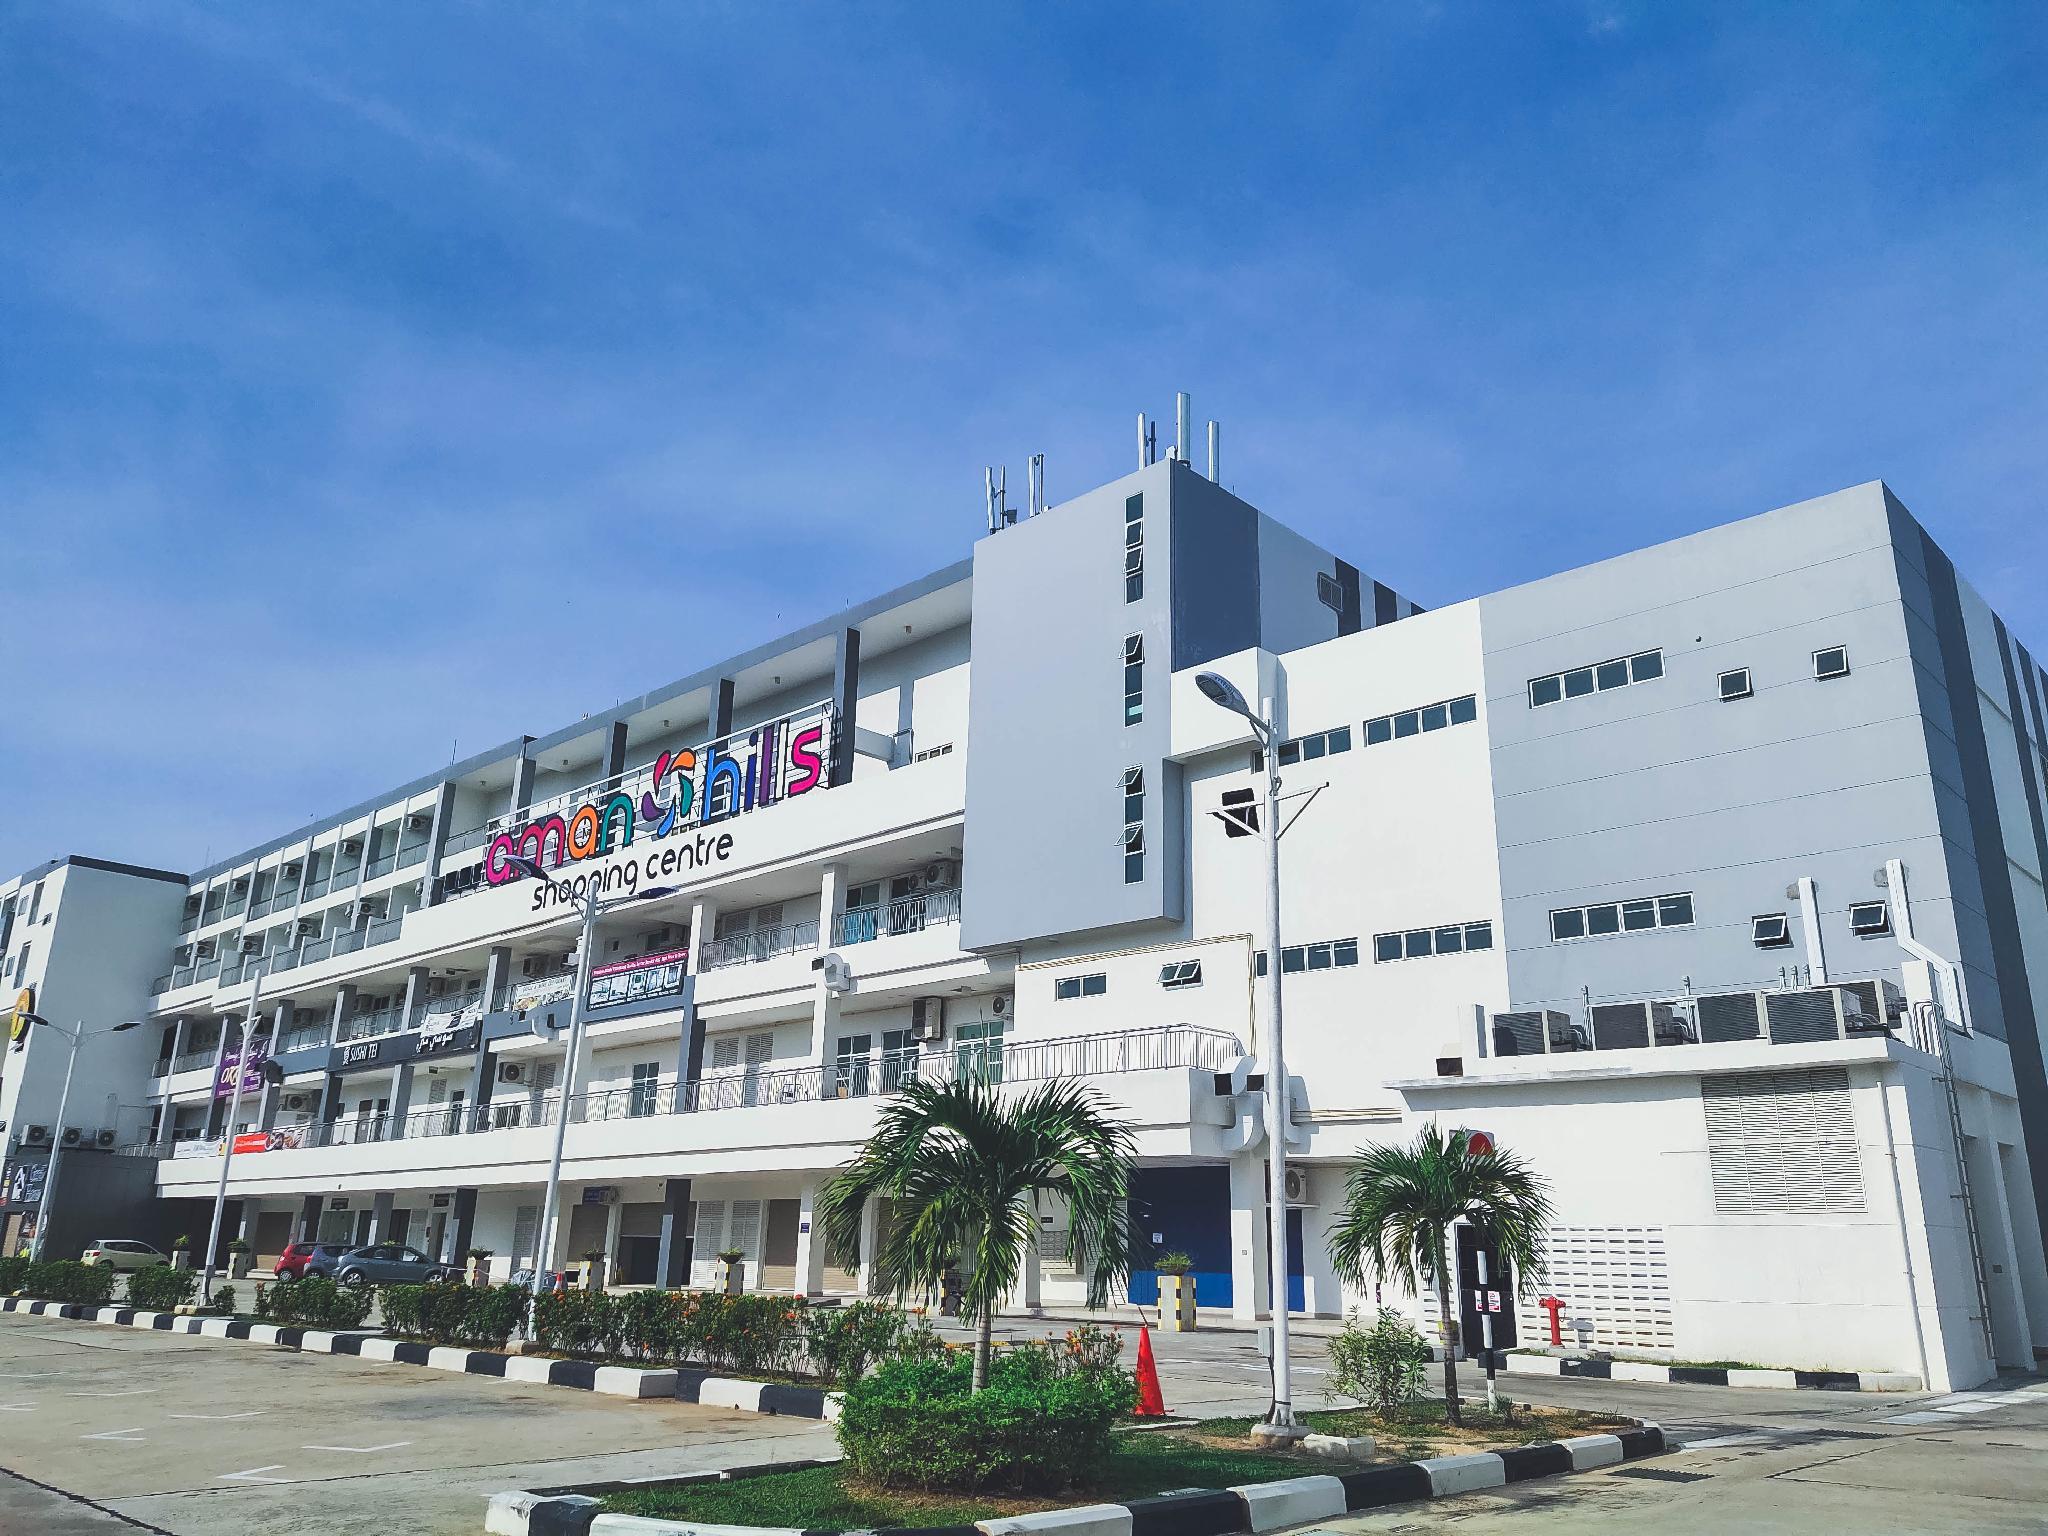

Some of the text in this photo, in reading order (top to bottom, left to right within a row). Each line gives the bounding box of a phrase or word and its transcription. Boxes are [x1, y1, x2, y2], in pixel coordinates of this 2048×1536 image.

[486, 719, 823, 885] aman hills
[531, 833, 734, 911] shopping centre
[350, 1045, 368, 1062] SUSHI
